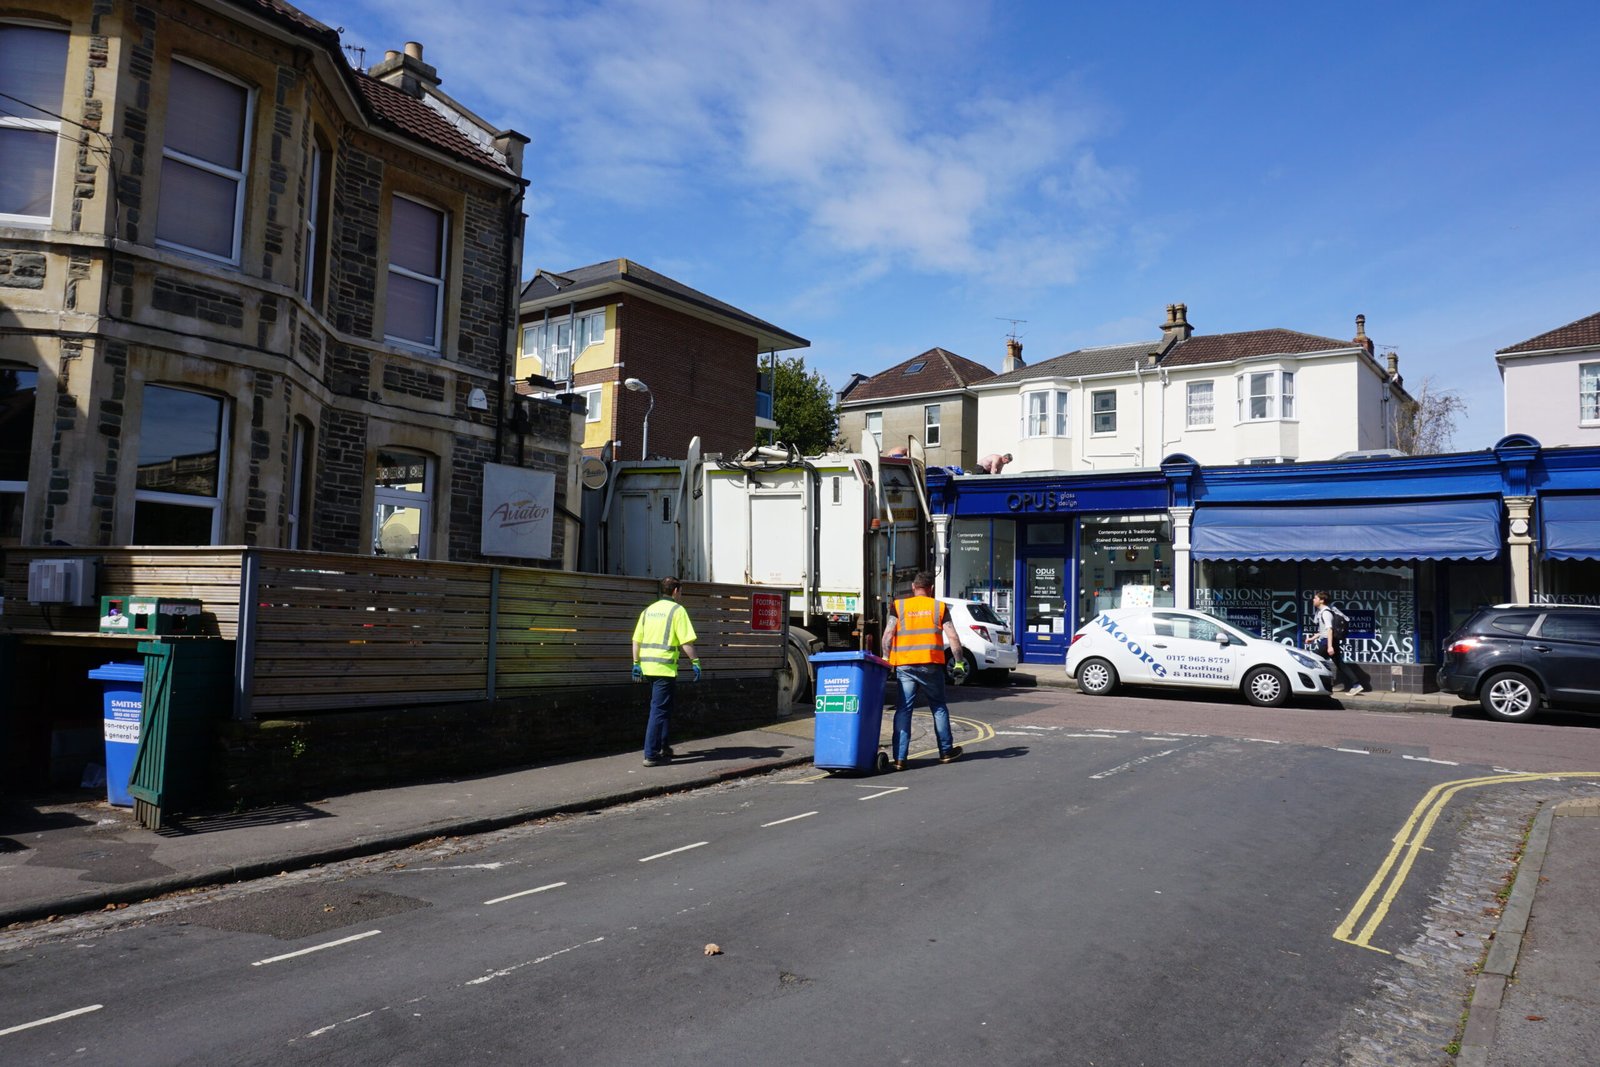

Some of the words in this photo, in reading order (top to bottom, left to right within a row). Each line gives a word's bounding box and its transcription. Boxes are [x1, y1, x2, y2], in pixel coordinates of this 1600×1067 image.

[1060, 492, 1075, 500] glass
[1007, 491, 1057, 511] OPUS
[488, 502, 550, 522] Aviator
[1196, 588, 1271, 601] PENSIONS
[1095, 614, 1167, 678] Moore
[1208, 656, 1230, 664] 8779
[1179, 664, 1223, 673] Roofing
[1183, 672, 1230, 681] Building
[111, 700, 142, 709] SMITHS
